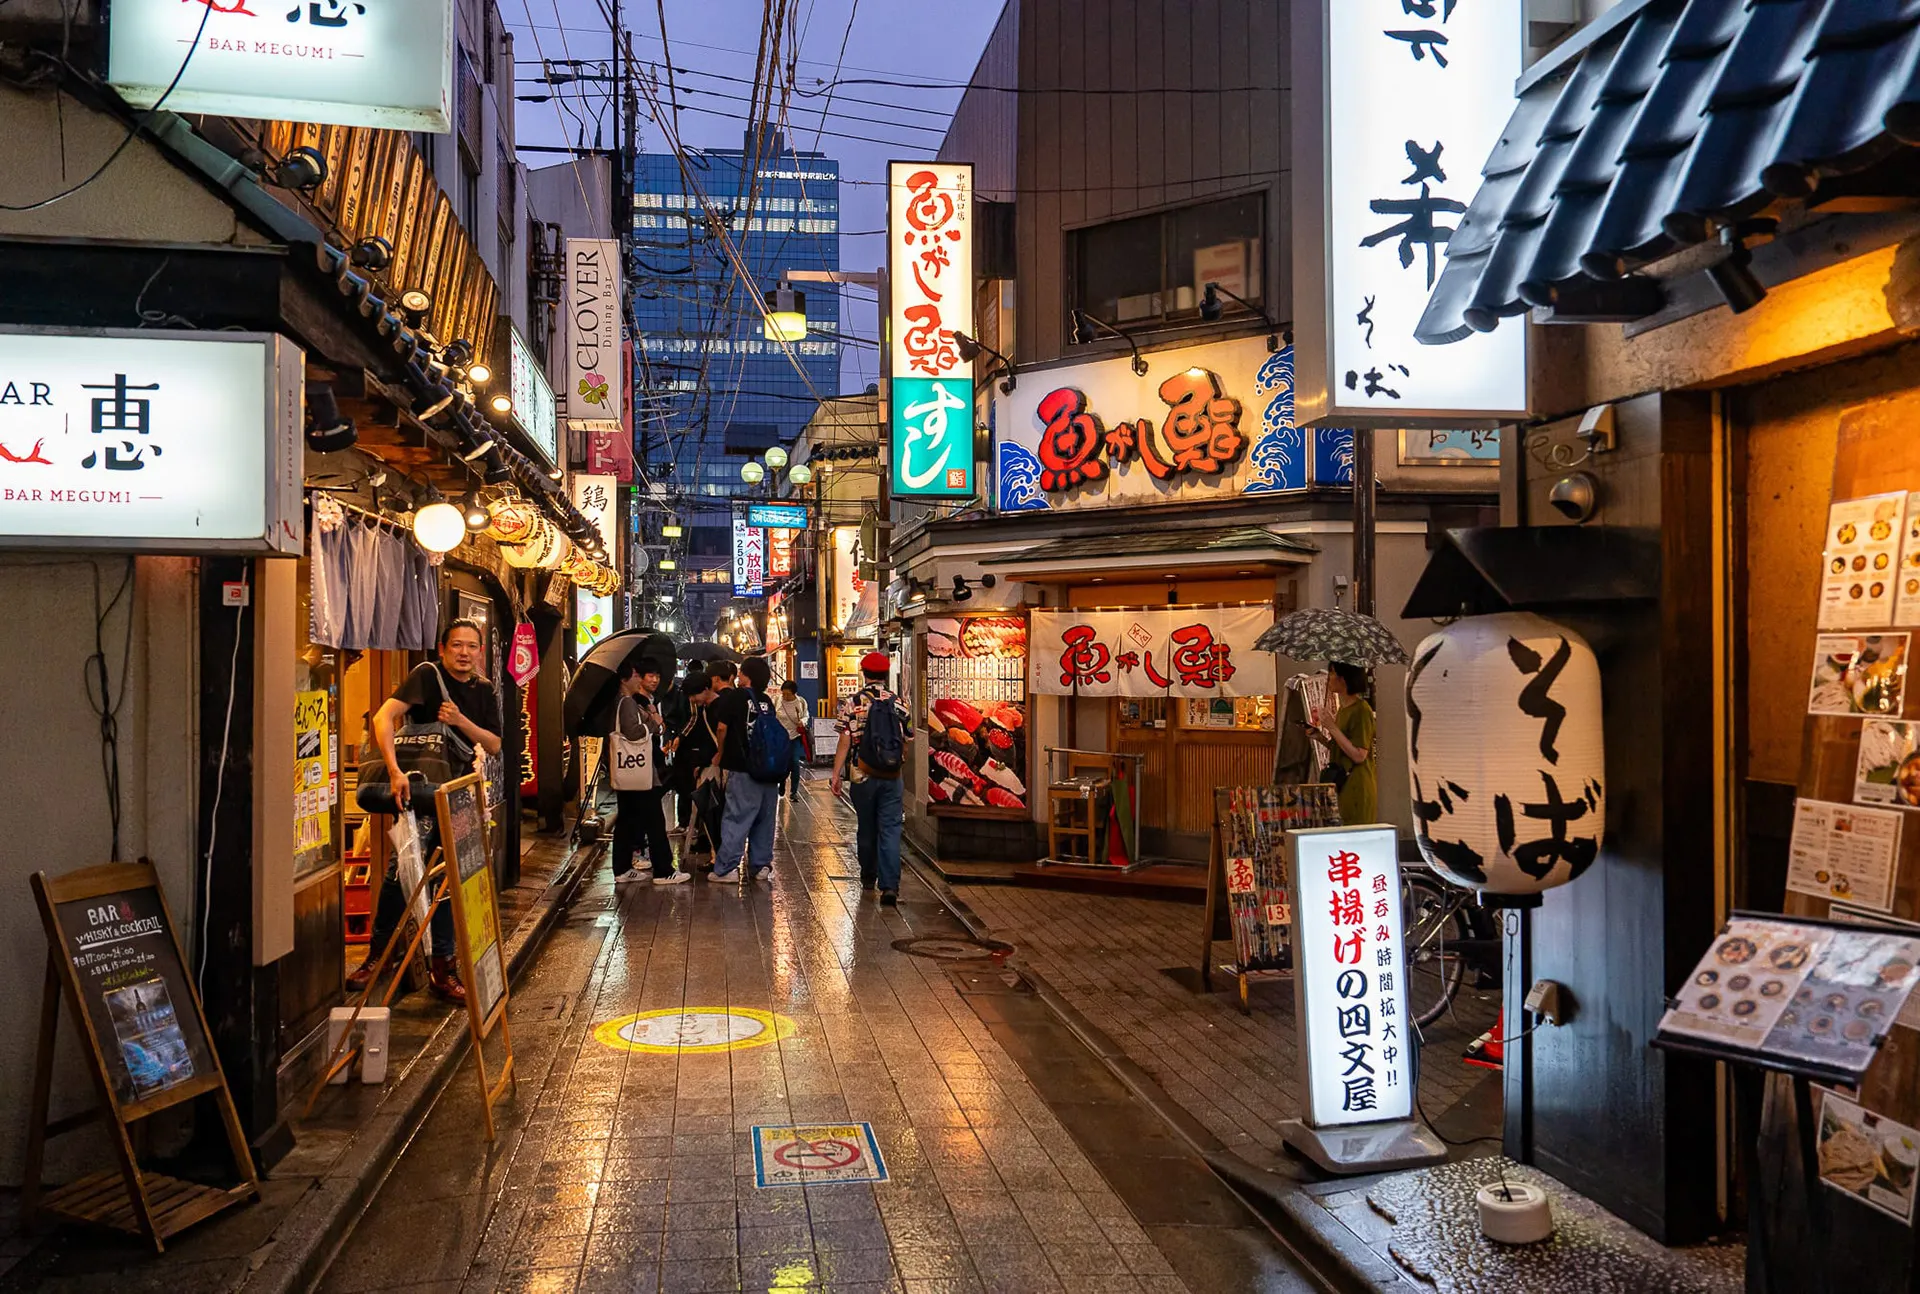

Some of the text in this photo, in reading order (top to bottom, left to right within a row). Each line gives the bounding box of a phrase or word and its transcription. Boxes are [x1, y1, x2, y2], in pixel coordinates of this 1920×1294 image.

[209, 37, 334, 59] BAR MEGUMI
[956, 172, 966, 222] 中野北口店
[904, 170, 961, 376] 魚がし鮨
[576, 249, 599, 372] CLOVER
[602, 275, 614, 348] Dining Bar
[1345, 294, 1410, 399] そば
[81, 373, 163, 471] 恵
[901, 381, 966, 490] すし
[1038, 367, 1243, 491] 魚がし鮨
[4, 488, 131, 503] BAR MEGUMI
[1060, 623, 1237, 688] 魚がし鮨
[394, 734, 444, 745] DIESEL
[617, 751, 646, 769] Lee
[1494, 634, 1602, 883] そば
[75, 926, 113, 944] WHISKY
[120, 916, 162, 934] COCKTAIL
[87, 904, 120, 926] BAR
[1267, 905, 1291, 921] 13
[1327, 849, 1378, 1112] 串揚げの四文屋
[1372, 873, 1398, 1087] 昼呑み時間拡大中!!
